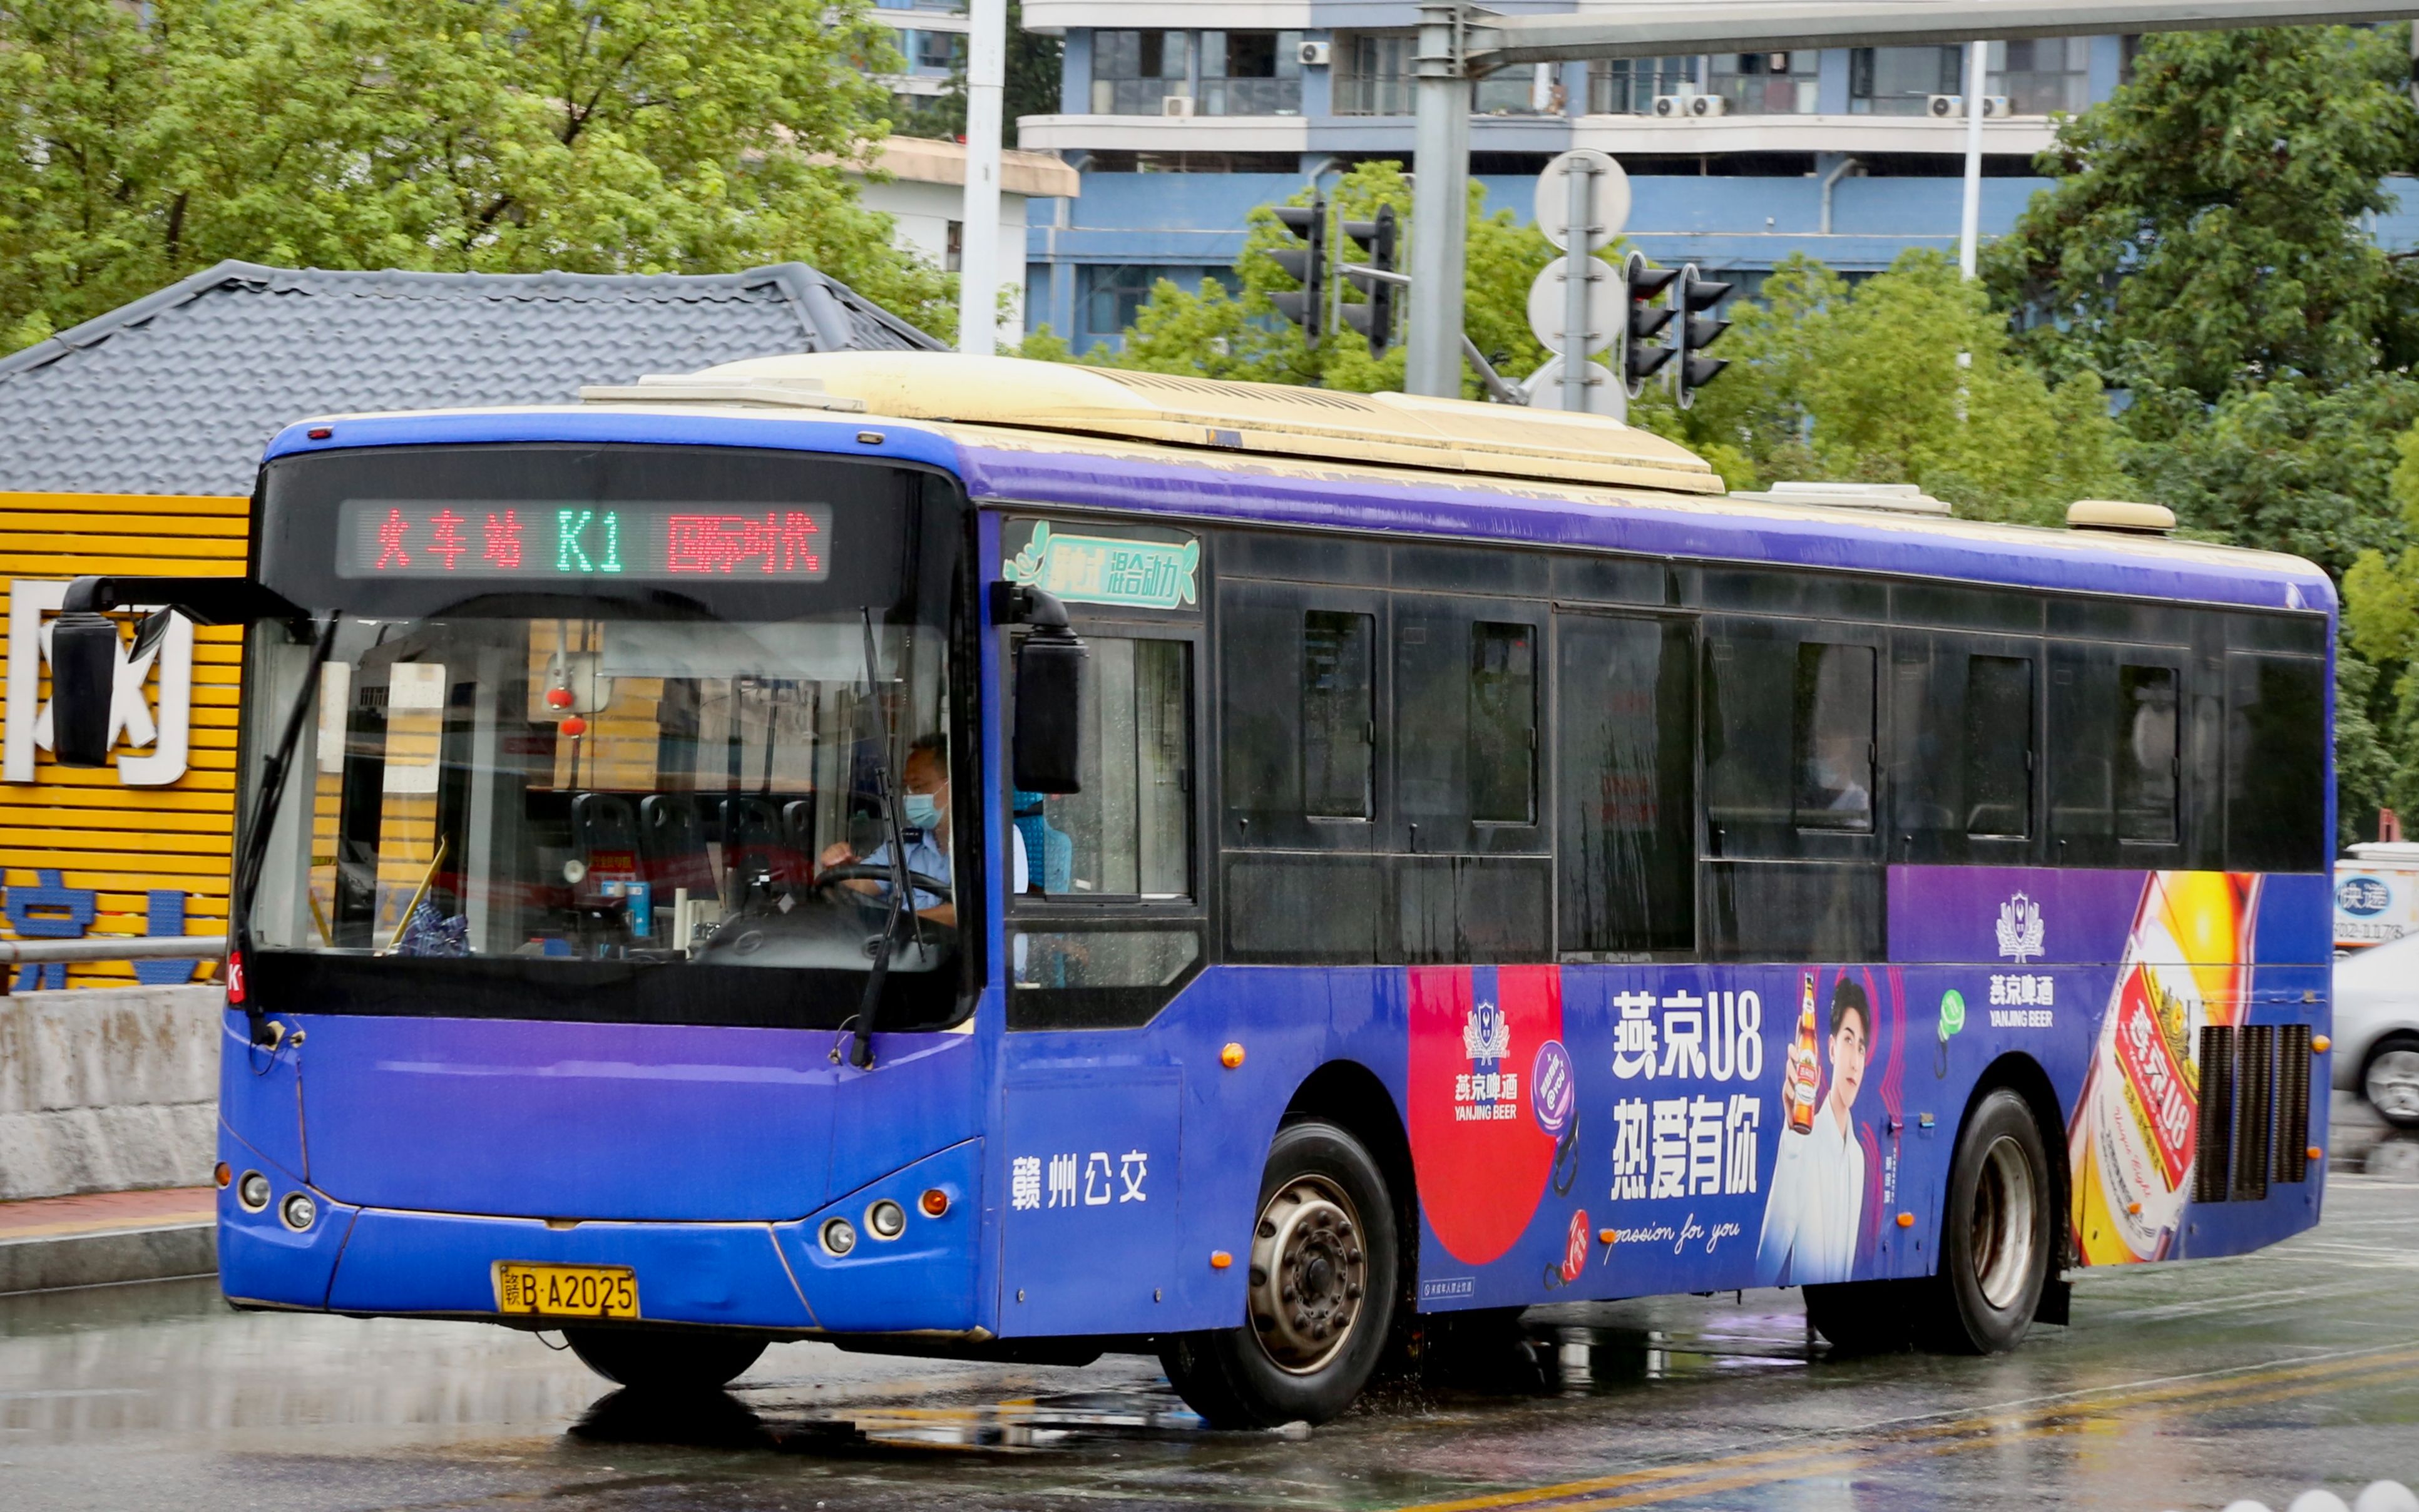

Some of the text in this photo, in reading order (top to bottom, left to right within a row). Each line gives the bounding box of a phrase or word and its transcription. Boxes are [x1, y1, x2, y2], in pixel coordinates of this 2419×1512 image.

[377, 509, 524, 570] 火车站
[556, 509, 621, 571] K1
[1990, 974, 2053, 1006] 燕京啤酒
[1612, 989, 1762, 1082] 燕京U8
[1990, 1010, 2053, 1027] YANJING BEER
[1455, 1073, 1517, 1101] 燕京啤酒
[1455, 1104, 1516, 1121] YANJING BEER
[1611, 1094, 1761, 1201] 热爱有你
[1011, 1149, 1148, 1211] 赣州公交
[1674, 1213, 1704, 1255] for
[1706, 1222, 1740, 1254] you
